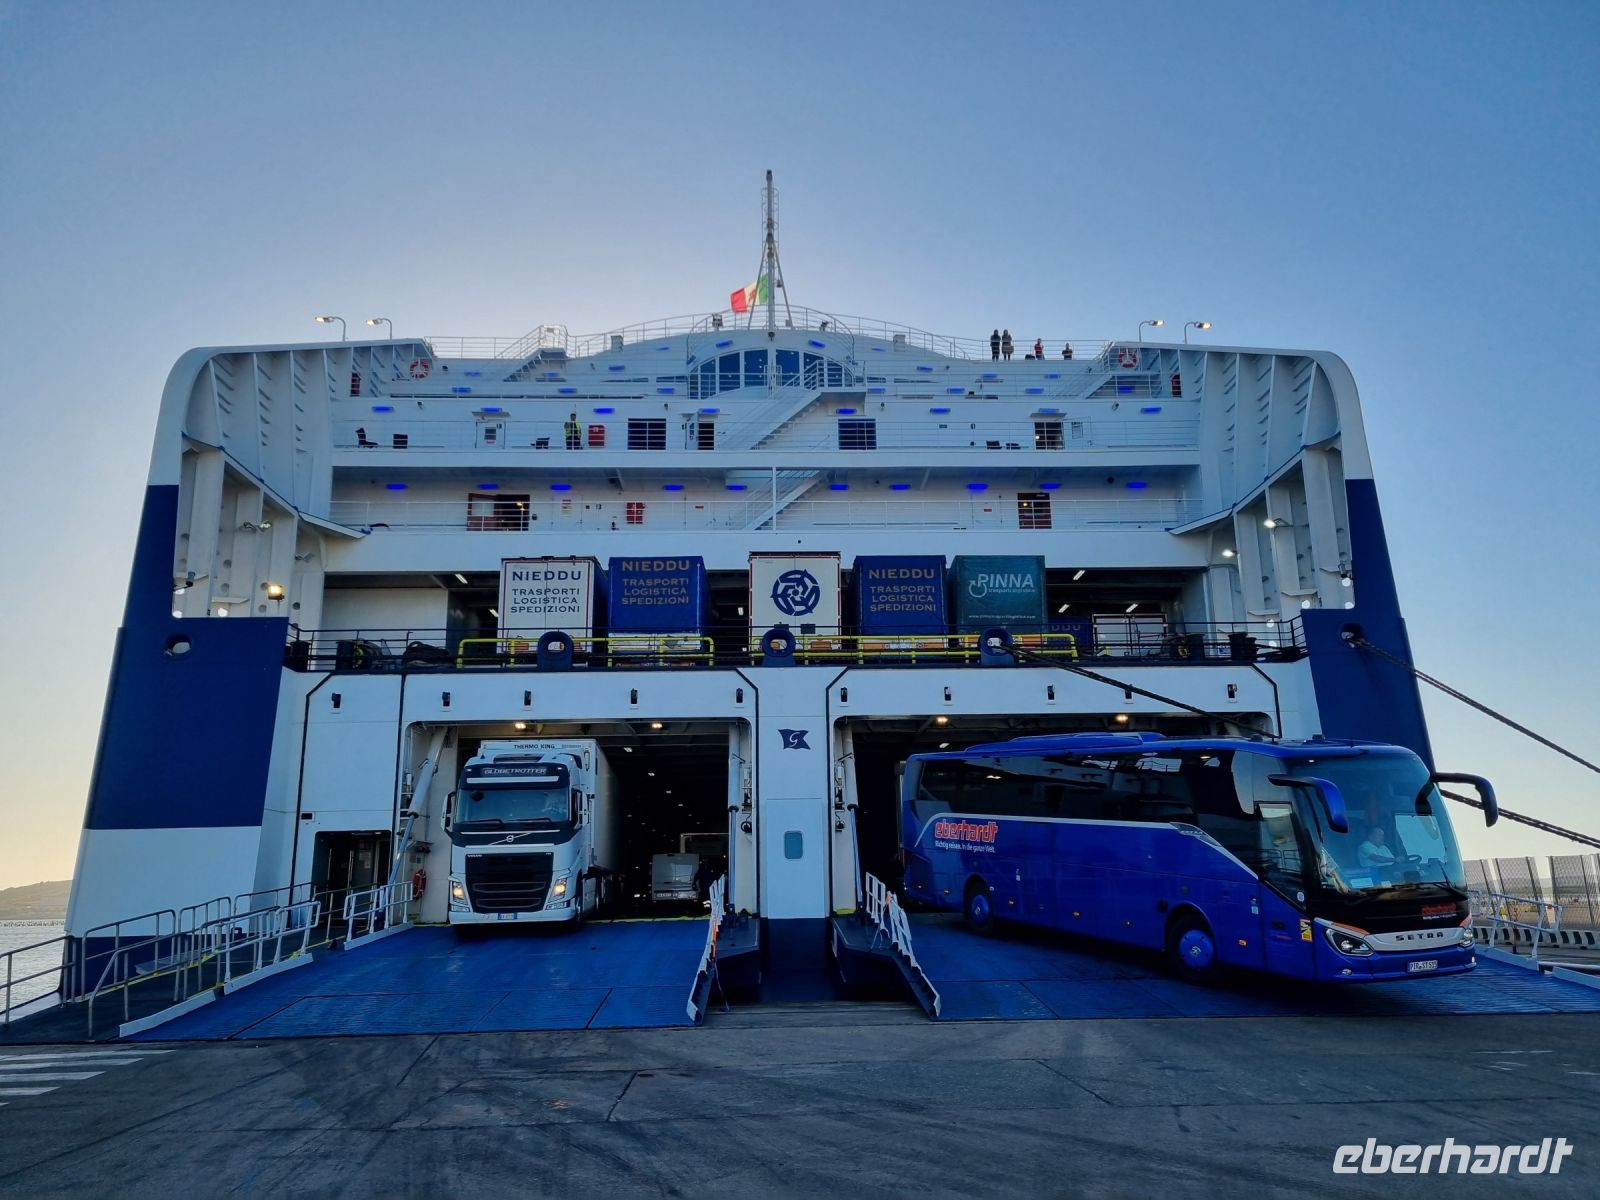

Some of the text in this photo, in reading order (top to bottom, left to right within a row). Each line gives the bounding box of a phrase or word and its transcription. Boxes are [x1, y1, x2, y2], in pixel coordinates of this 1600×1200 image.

[622, 560, 689, 571] NIEDDU
[512, 571, 581, 581] NIEDDU
[868, 569, 935, 579] NIEDDU
[622, 578, 689, 586] TRASPORTI
[978, 574, 1034, 588] PINNA
[513, 588, 580, 596] TRASPORTI
[622, 596, 689, 605] SPEDIZIONI
[870, 604, 936, 612] SPEDIZIONI
[935, 819, 998, 843] eberhardt
[1396, 932, 1443, 941] SETRA
